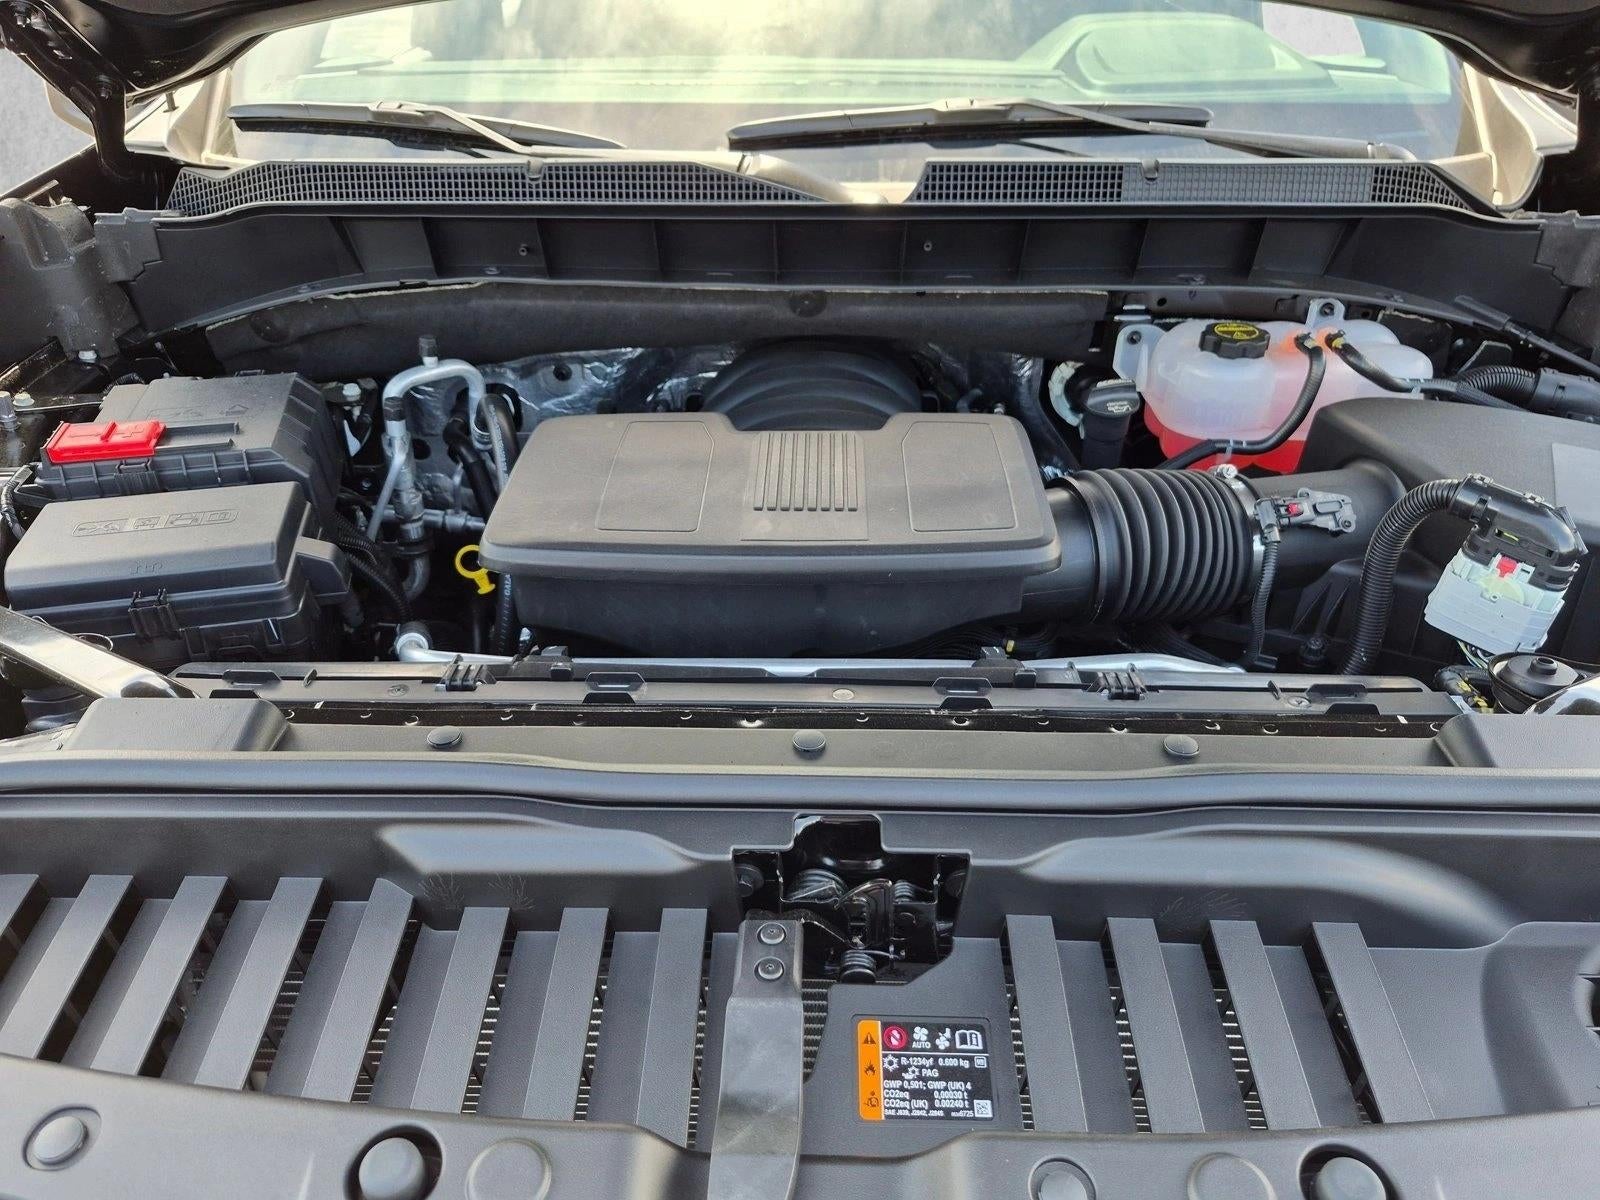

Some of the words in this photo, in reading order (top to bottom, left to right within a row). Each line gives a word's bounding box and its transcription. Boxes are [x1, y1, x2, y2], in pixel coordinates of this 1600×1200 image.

[912, 1041, 931, 1049] AUTO
[900, 1057, 934, 1067] R-1234yf
[959, 1058, 970, 1068] kg
[921, 1068, 939, 1077] PAG
[883, 1080, 902, 1088] GWP
[927, 1081, 947, 1089] GWP
[947, 1081, 965, 1091] (UK)
[966, 1082, 972, 1090] 4
[883, 1089, 910, 1099] CO2eq
[963, 1091, 969, 1099] t
[884, 1099, 910, 1109] CO2eq
[911, 1099, 928, 1109] (UK)
[964, 1100, 970, 1108] t
